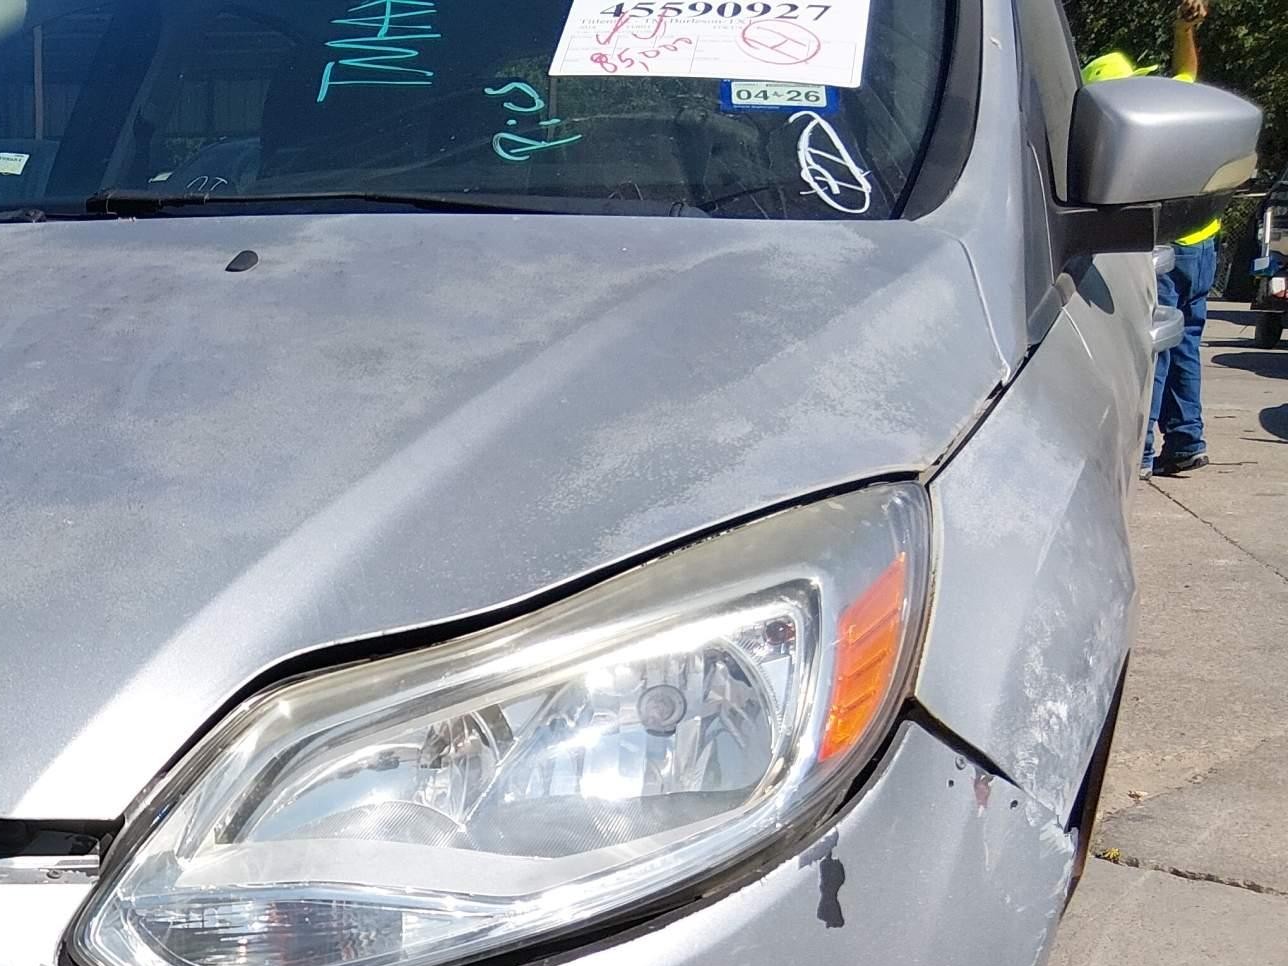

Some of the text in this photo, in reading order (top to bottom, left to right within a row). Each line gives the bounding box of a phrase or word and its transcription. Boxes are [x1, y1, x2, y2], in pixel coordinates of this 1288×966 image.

[599, 1, 832, 21] 45590927
[316, 0, 441, 102] TMA
[735, 89, 821, 102] 04 26
